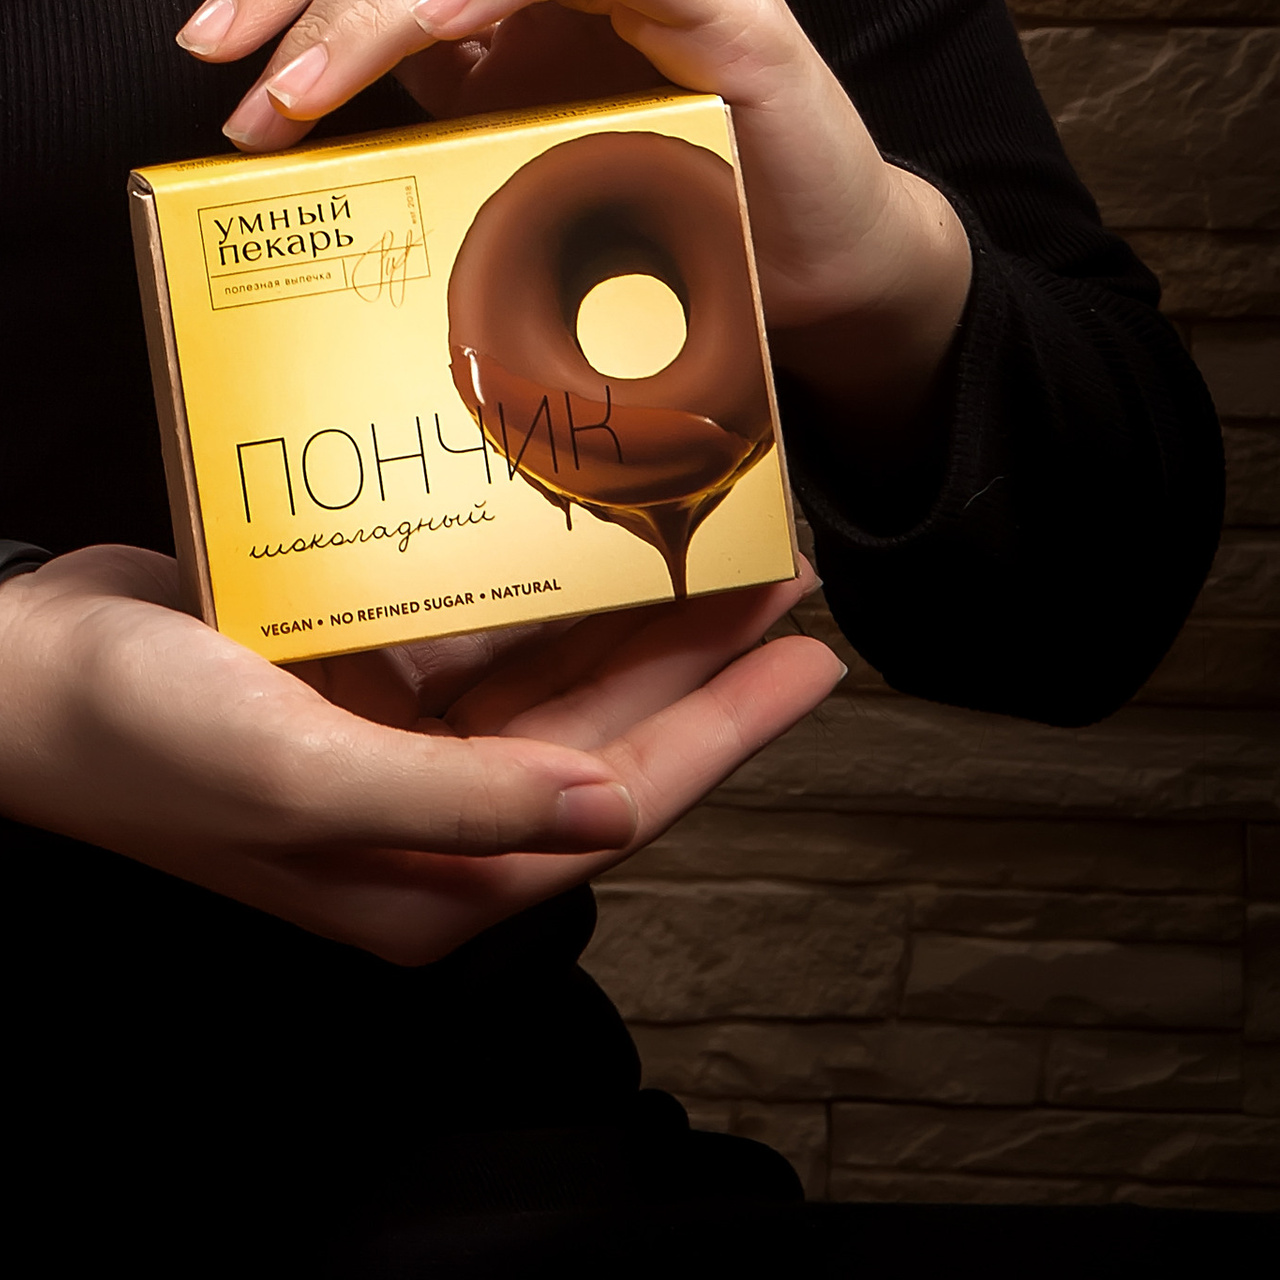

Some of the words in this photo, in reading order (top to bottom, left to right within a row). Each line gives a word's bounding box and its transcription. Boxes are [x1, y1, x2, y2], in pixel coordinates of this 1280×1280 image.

[214, 194, 352, 246] умный
[218, 228, 354, 266] пекарь
[224, 280, 281, 295] полезная
[285, 271, 332, 286] выпечка
[236, 385, 624, 524] ПОНЧИК
[249, 500, 496, 560] шоколадный
[261, 618, 313, 638] VEGAN
[330, 611, 354, 627] NO
[357, 601, 420, 622] REFINED
[423, 592, 475, 611] SUGAR
[490, 578, 562, 600] NATURAL
